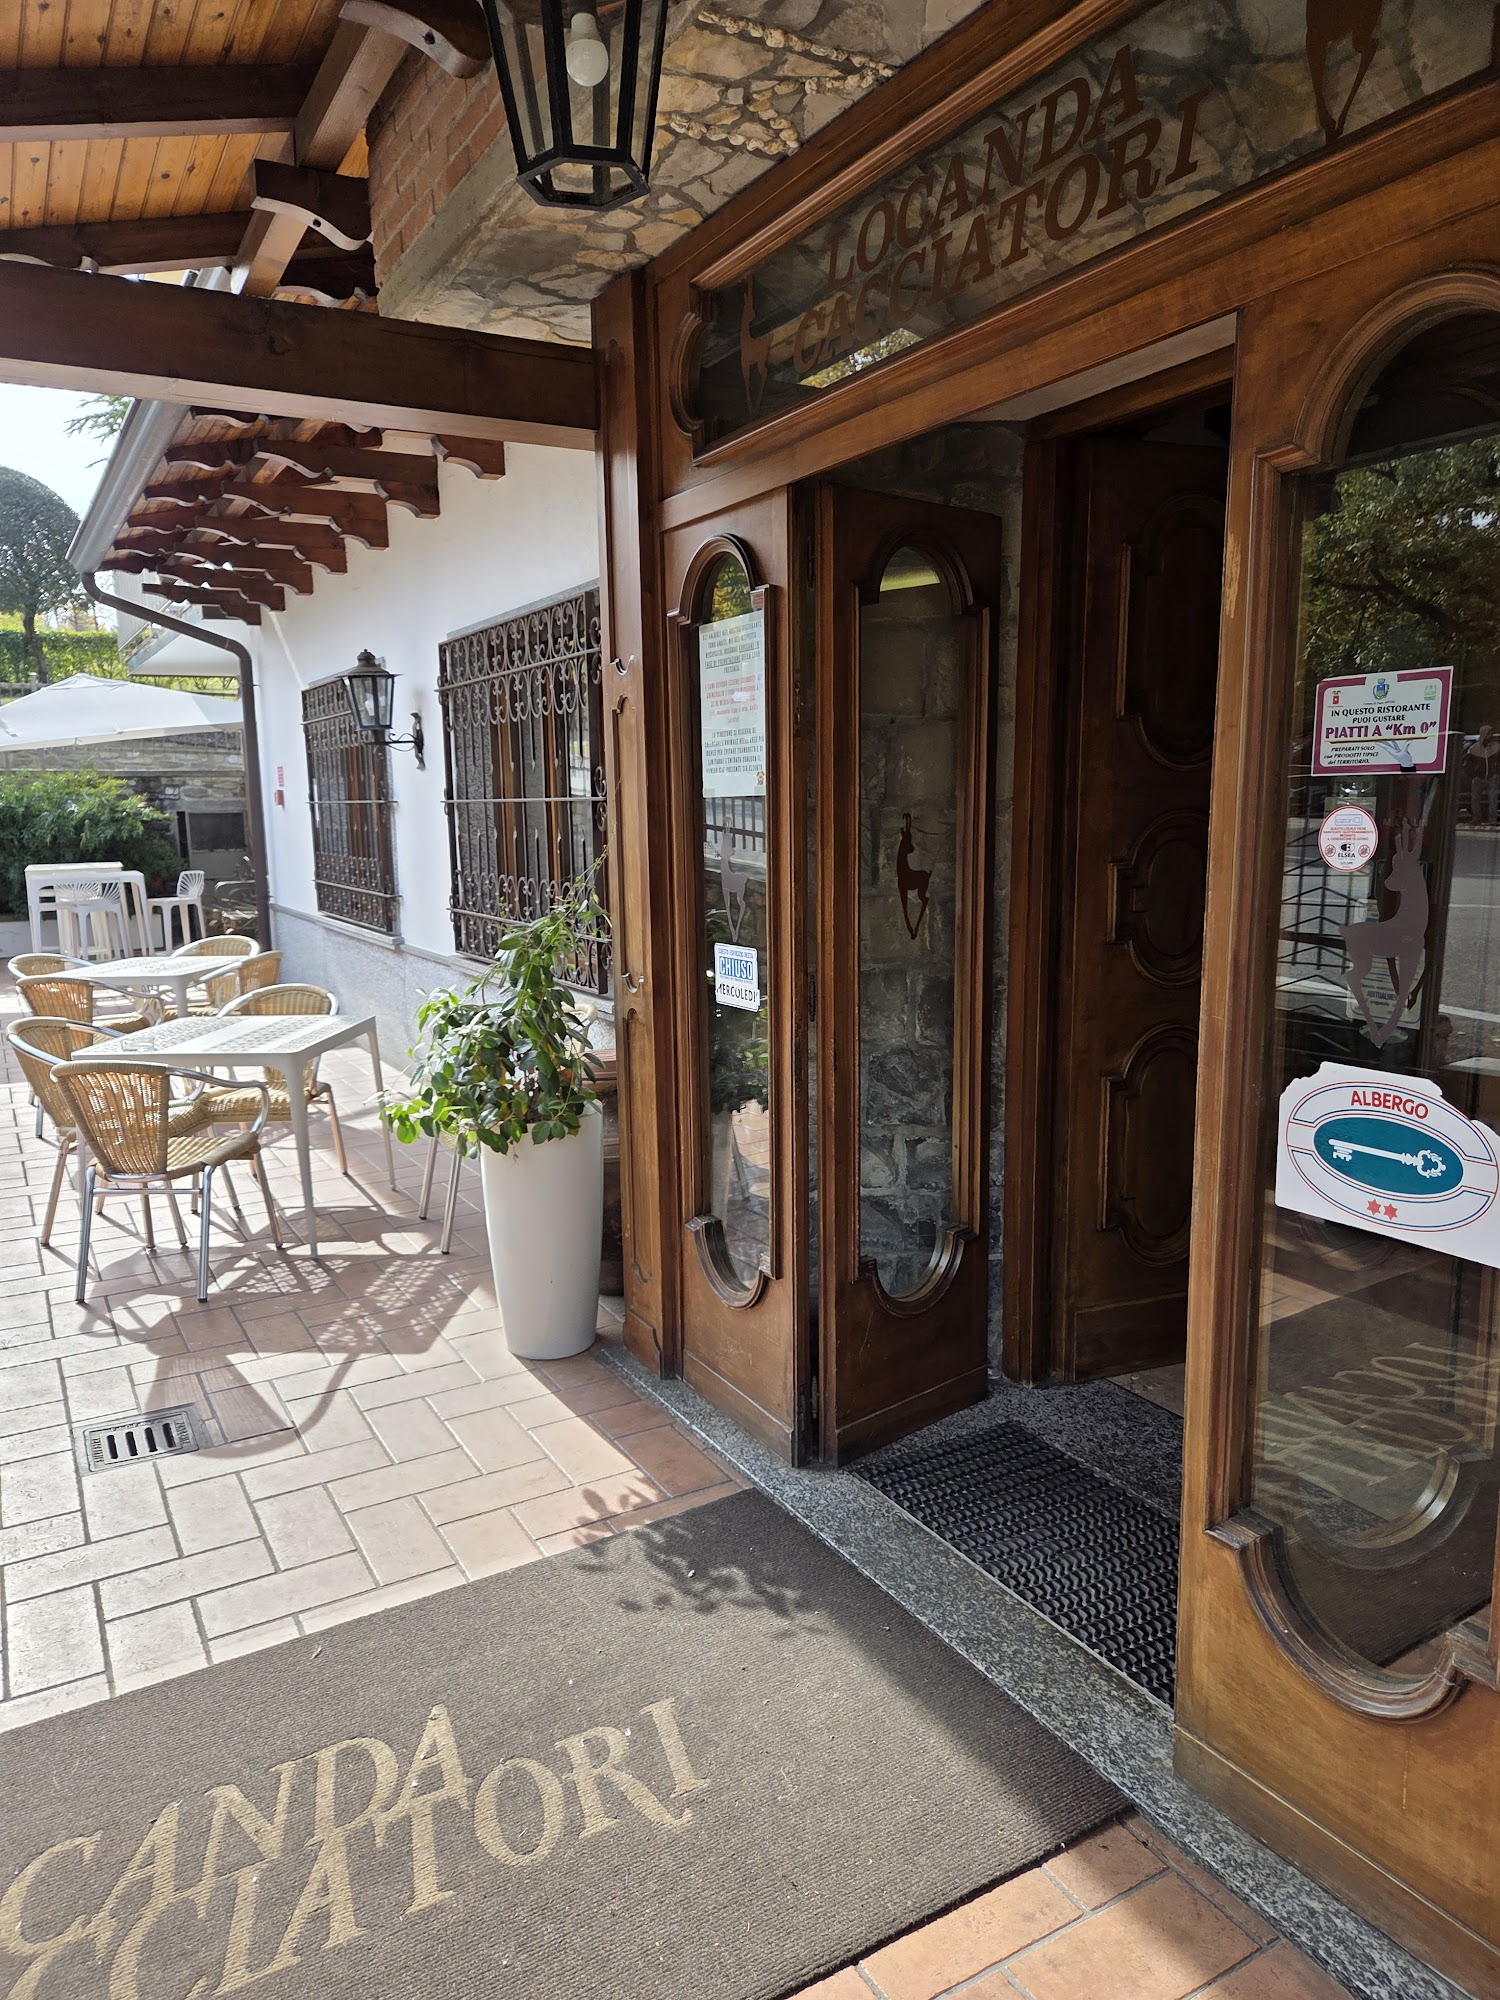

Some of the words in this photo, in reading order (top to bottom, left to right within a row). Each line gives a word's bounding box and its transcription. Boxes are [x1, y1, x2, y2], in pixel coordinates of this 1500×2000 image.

[824, 43, 1144, 295] LOCANDA
[793, 88, 1206, 374] CACCIATORI
[1331, 709, 1340, 717] IN
[1342, 706, 1374, 716] QUESTO
[1377, 703, 1431, 714] RISTORANTE
[1352, 716, 1371, 724] PUOI
[1372, 714, 1405, 723] GUSTARE
[1325, 725, 1368, 739] PIATTI
[1372, 725, 1382, 737] A
[720, 957, 752, 980] CHIUSO
[1350, 1090, 1429, 1119] ALBERGO
